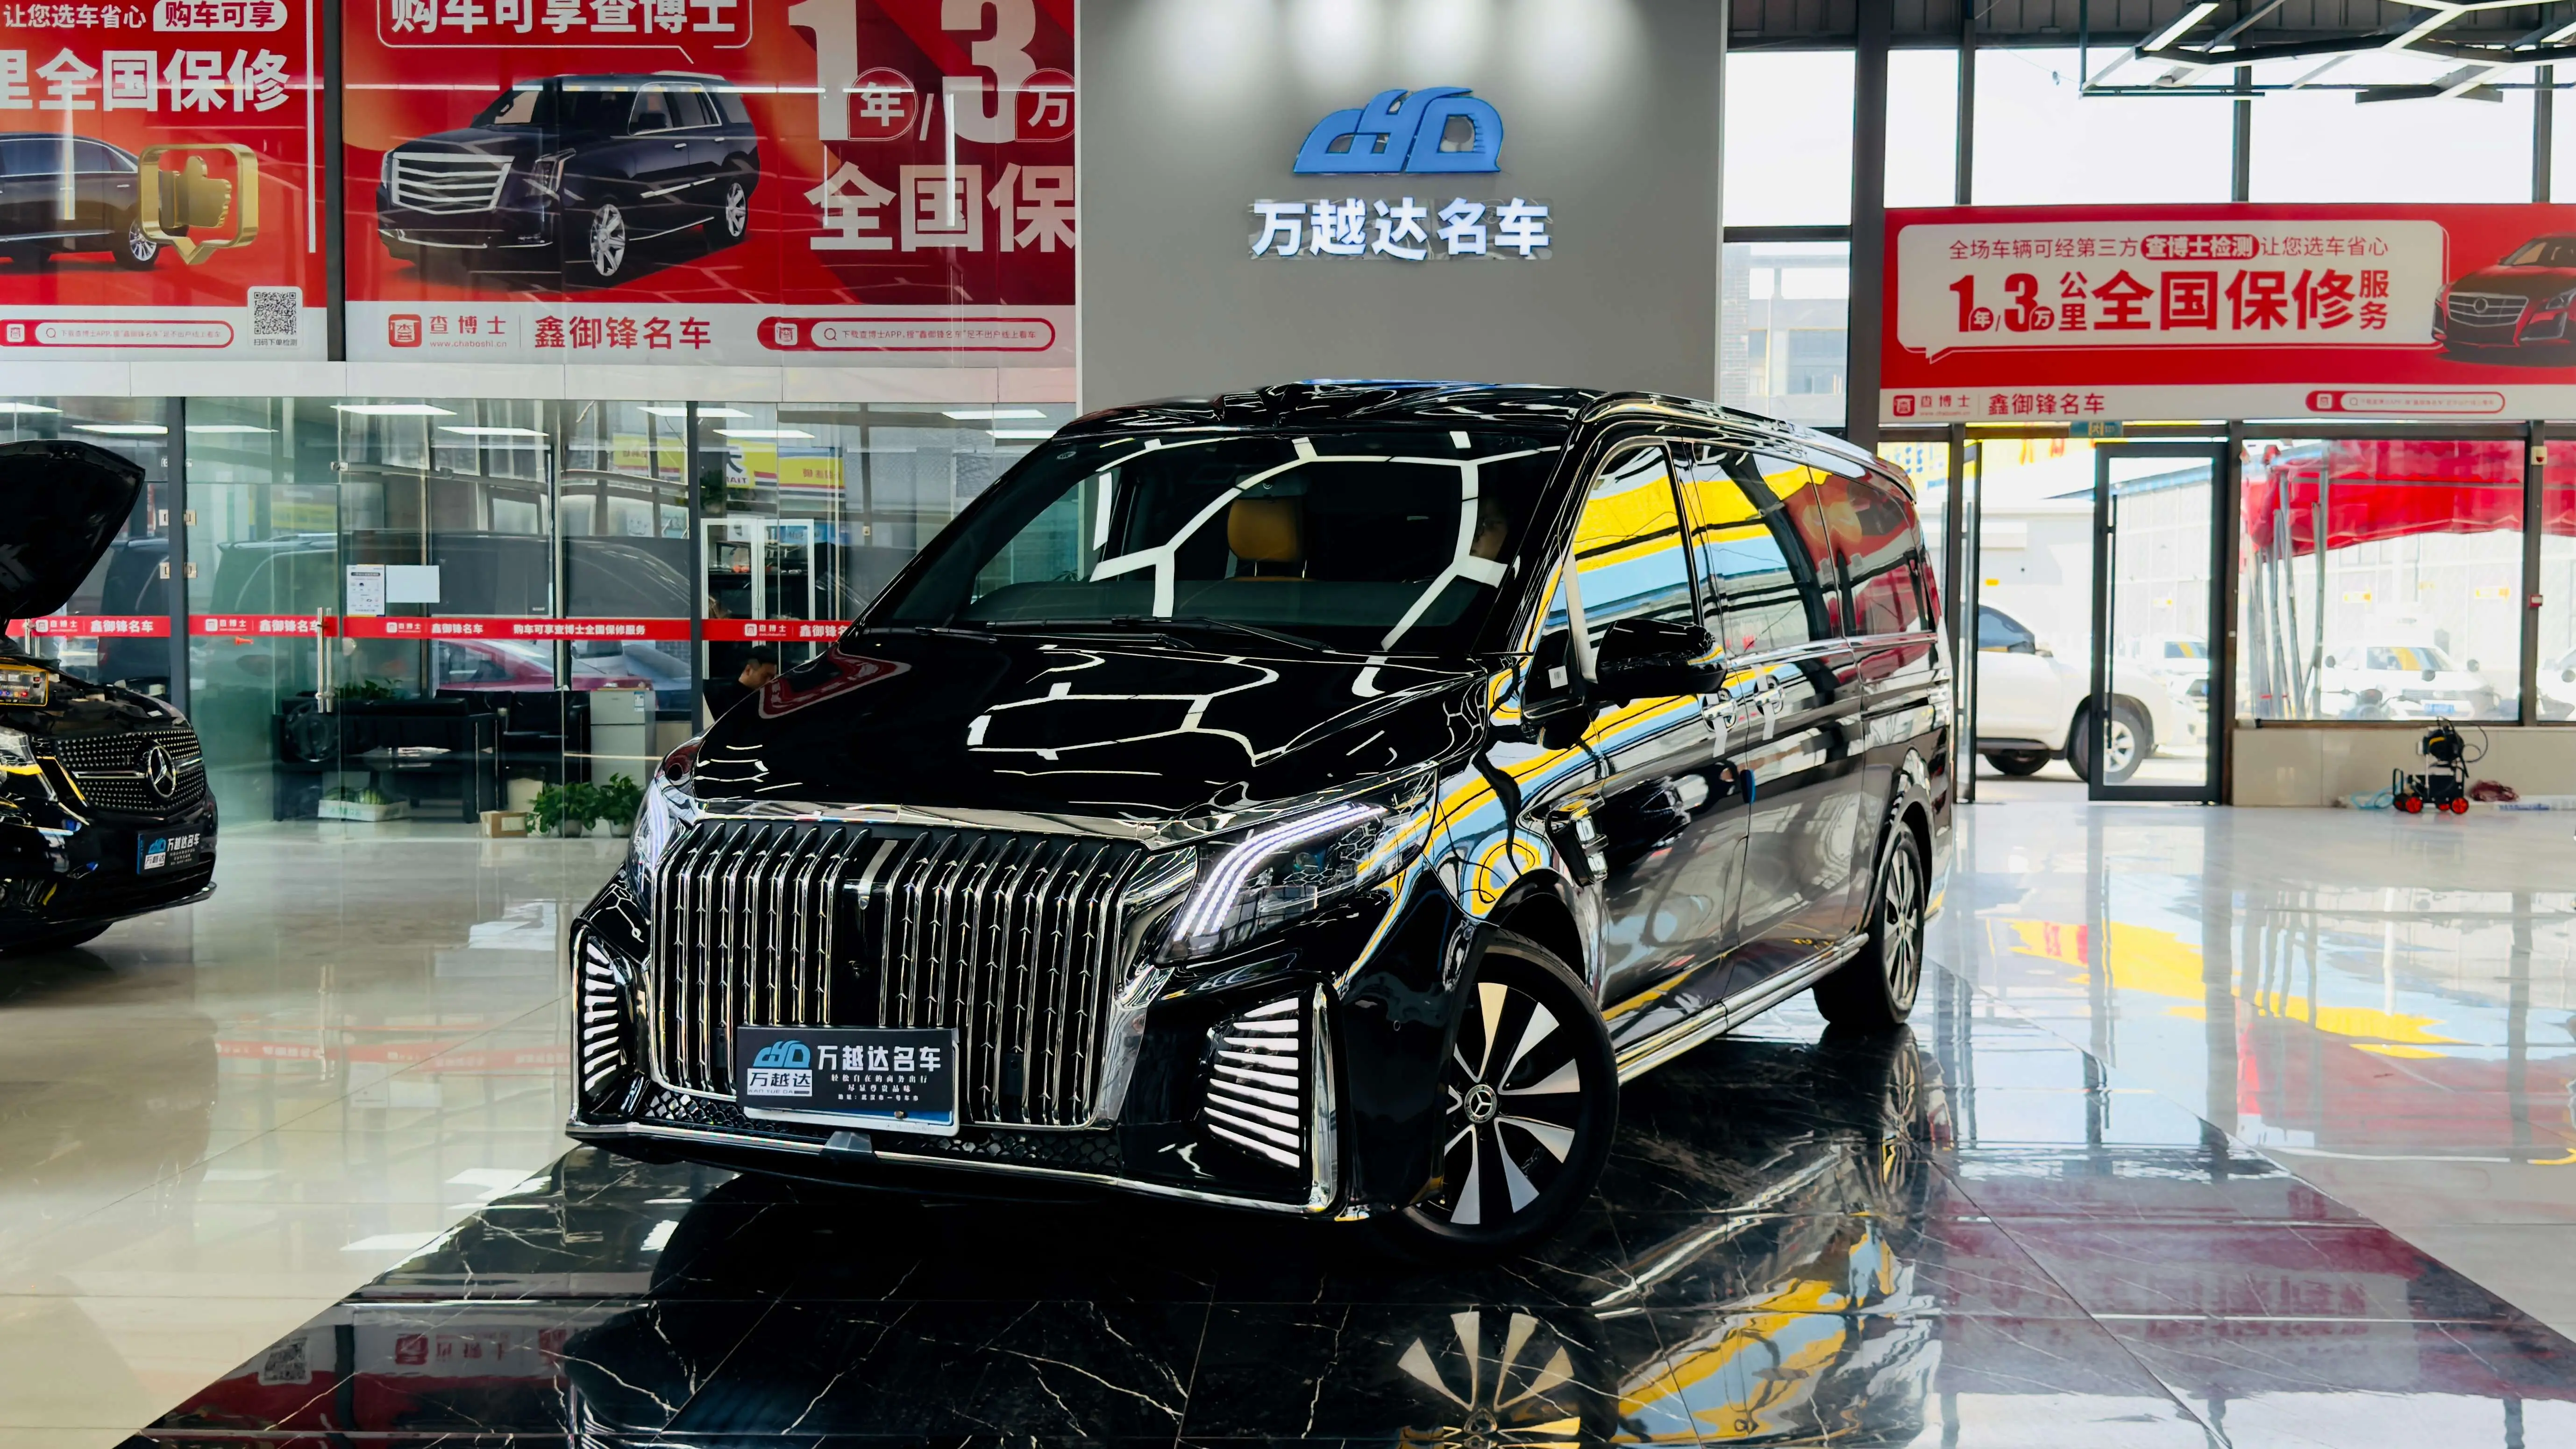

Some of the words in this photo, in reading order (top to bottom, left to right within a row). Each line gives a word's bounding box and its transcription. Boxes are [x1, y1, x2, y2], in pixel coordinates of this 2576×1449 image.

[4, 4, 146, 29] 让您选车省心
[165, 1, 276, 28] 购车可享
[391, 0, 736, 34] 购车可享查博士
[804, 160, 1075, 253] 全国保
[1252, 197, 1549, 261] 万越达名车
[1949, 238, 2138, 260] 全场车辆可经第三方
[2146, 235, 2253, 258] 查博士检测
[2261, 236, 2388, 257] 让您选车省心
[2092, 268, 2356, 331] 全国保修
[429, 315, 506, 334] 查博士
[534, 315, 712, 349] 鑫御锋名车
[1988, 393, 2105, 416] 鑫御锋名车
[817, 1045, 941, 1072] 万越达名车
[749, 1072, 811, 1087] 万越达
